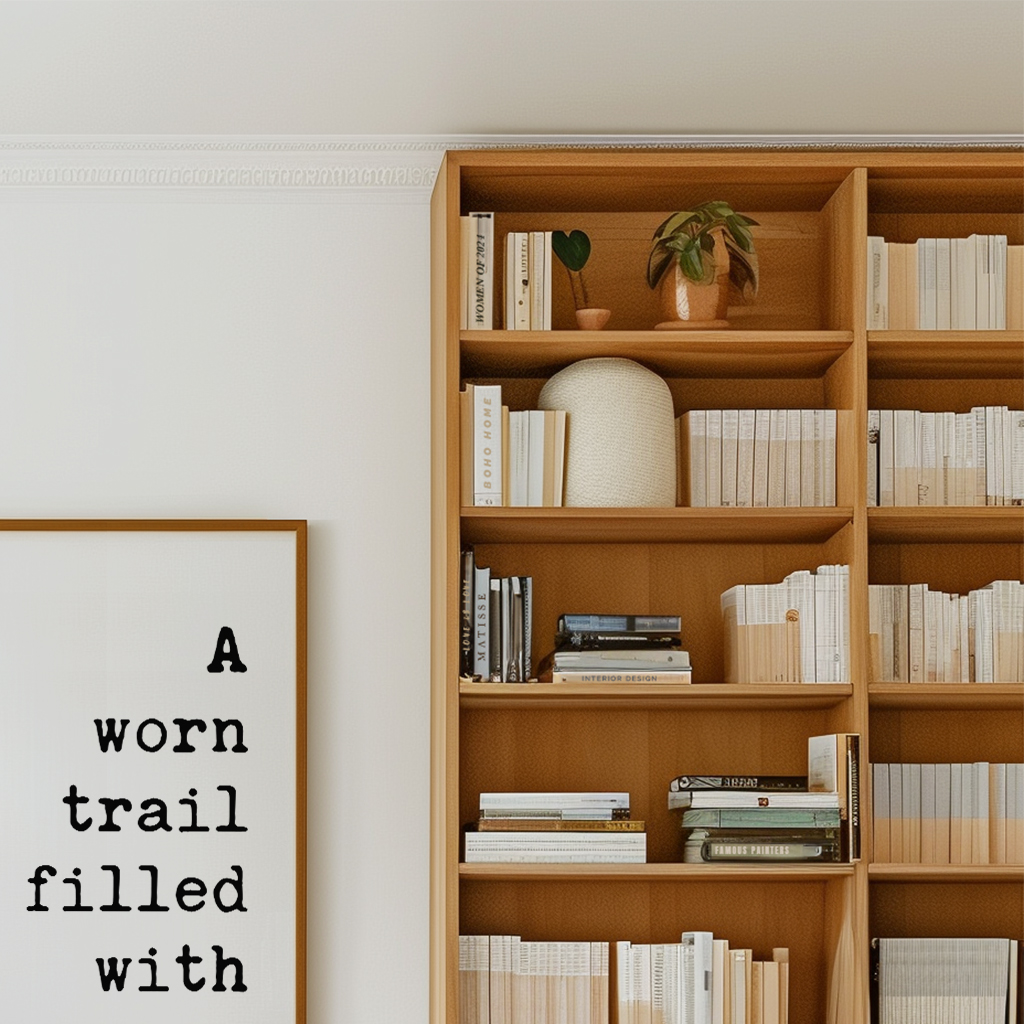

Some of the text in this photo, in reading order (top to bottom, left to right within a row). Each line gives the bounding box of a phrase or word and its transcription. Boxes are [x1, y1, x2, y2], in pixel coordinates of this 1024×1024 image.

[476, 234, 485, 323] WOMEN OF 2024
[483, 397, 492, 489] BOHO HOME
[207, 626, 247, 673] A
[477, 593, 487, 661] MATISSE
[94, 718, 248, 753] worn
[63, 785, 248, 833] trail
[714, 845, 789, 855] FAMOUS PAINTERS
[27, 865, 248, 913] filled
[96, 944, 247, 992] with
